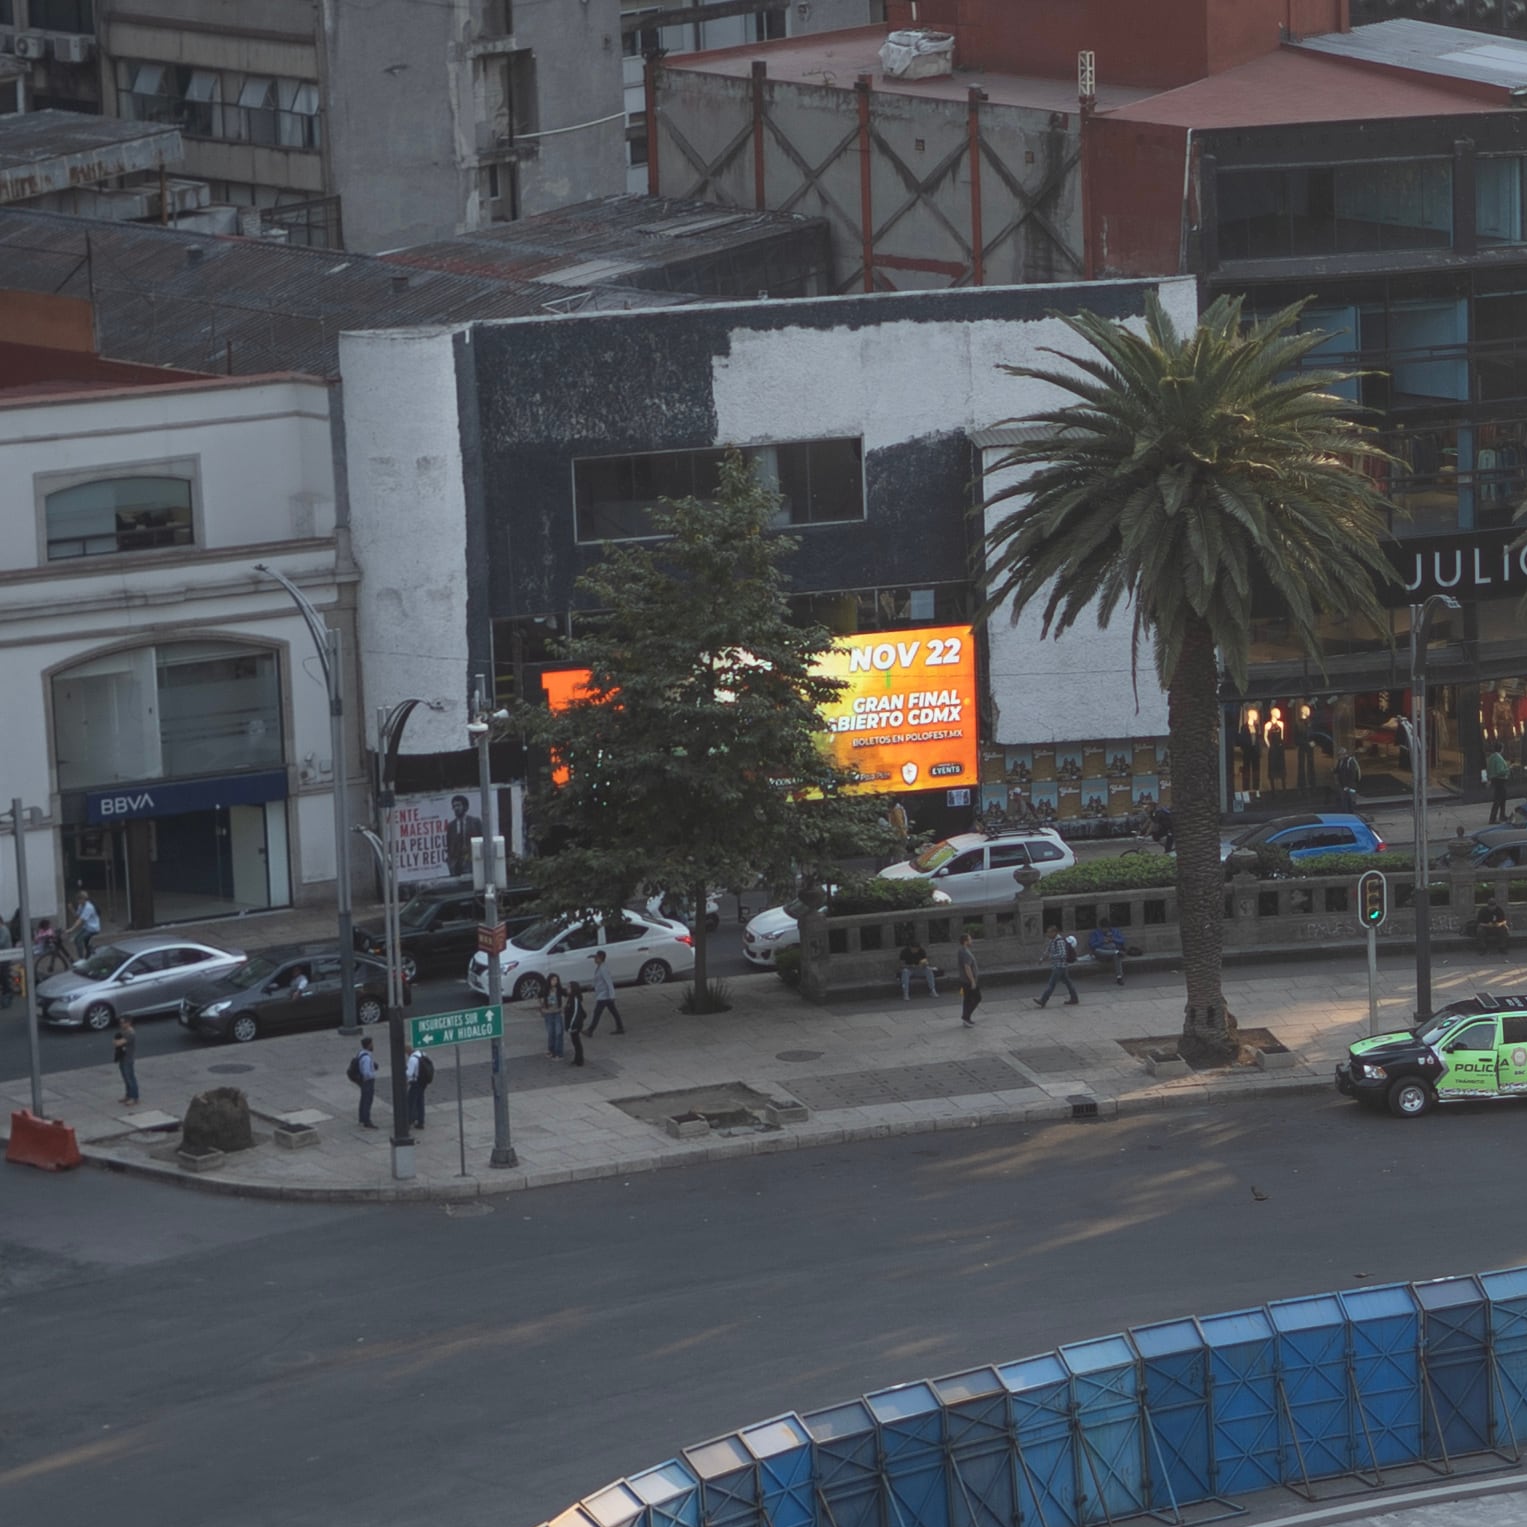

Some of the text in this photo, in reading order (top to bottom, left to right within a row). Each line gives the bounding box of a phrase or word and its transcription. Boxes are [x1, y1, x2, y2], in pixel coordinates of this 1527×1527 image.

[849, 638, 962, 672] NOV 22
[853, 689, 961, 714] GRAN FINAL
[907, 706, 963, 726] CDMX
[852, 735, 891, 747] BOLETOS
[893, 733, 904, 743] EN
[101, 792, 154, 815] BBVA
[400, 818, 450, 838] MAESTRA
[410, 834, 449, 852] PELICU
[418, 1011, 479, 1033] INSURGENTES SUR
[443, 1022, 494, 1041] AV HIDALGO
